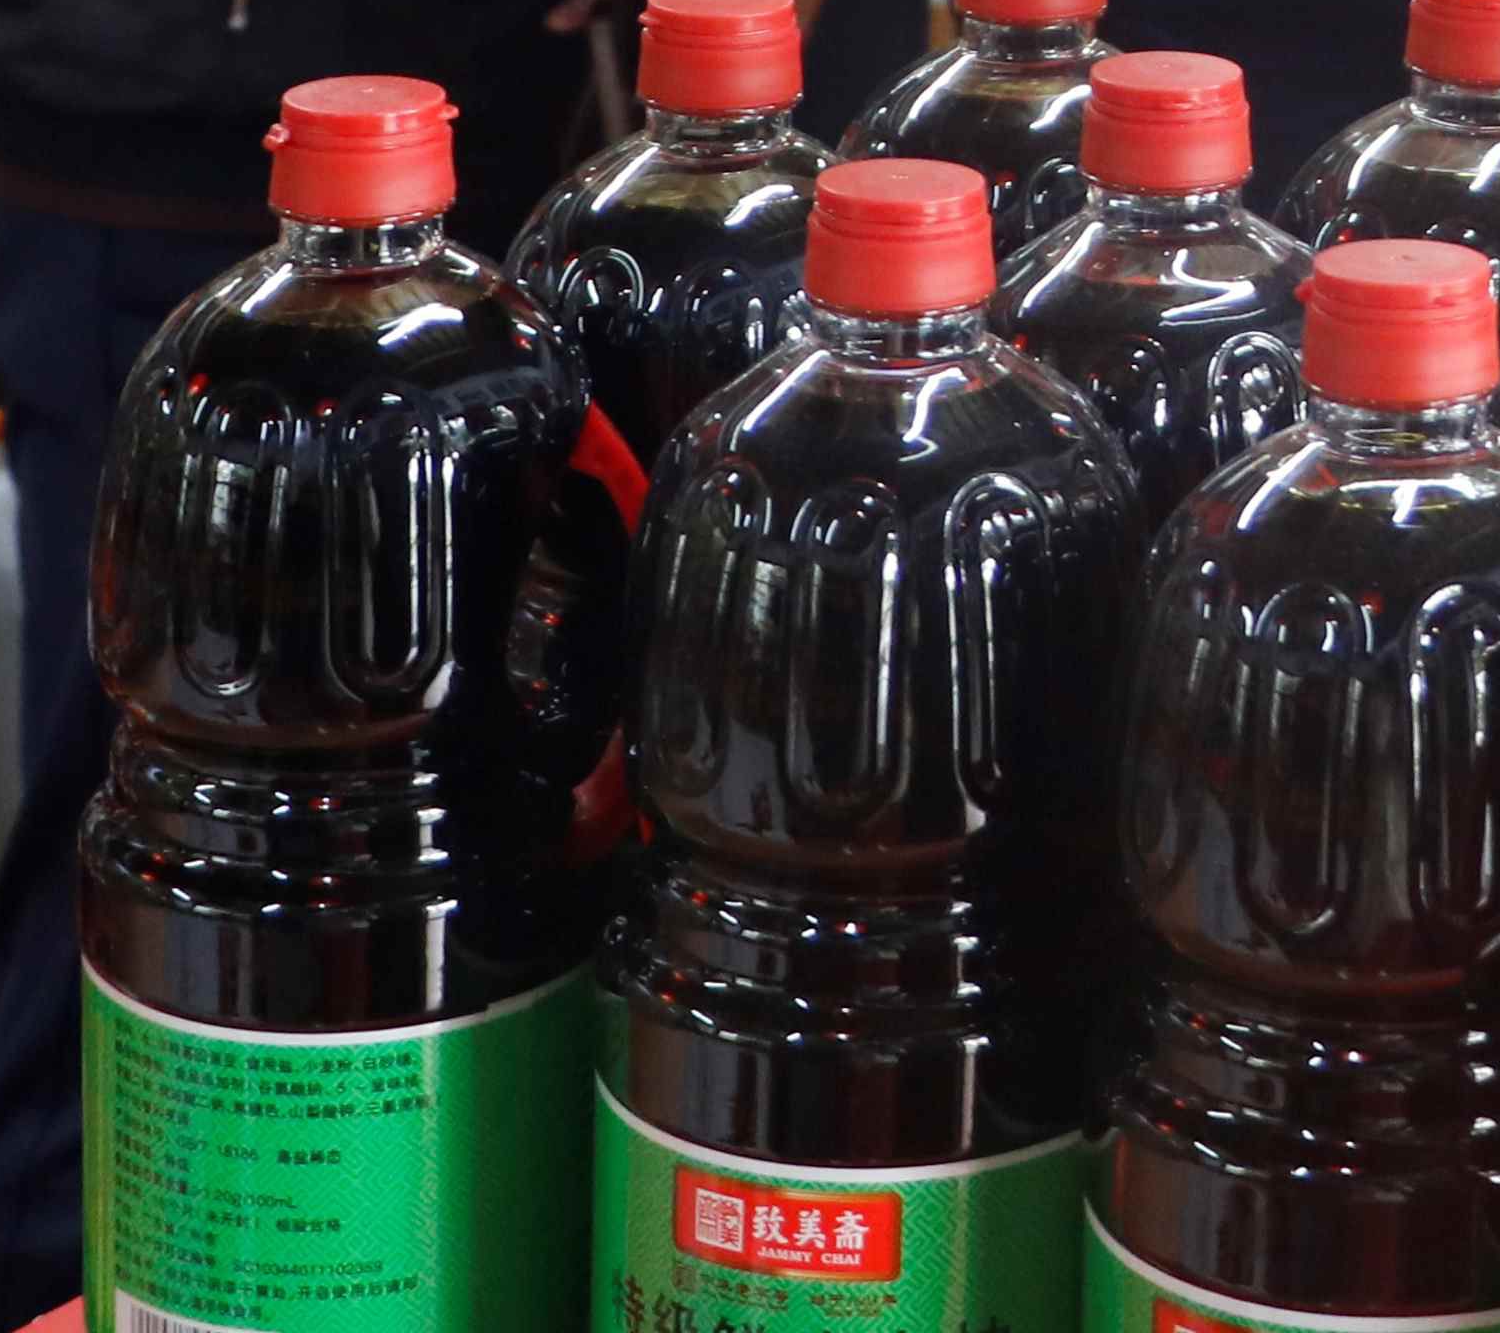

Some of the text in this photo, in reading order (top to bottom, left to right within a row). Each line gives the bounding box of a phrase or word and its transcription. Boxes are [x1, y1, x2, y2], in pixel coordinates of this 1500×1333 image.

[751, 1205, 869, 1250] 致美斋
[757, 1246, 861, 1267] JAMMY CHAI
